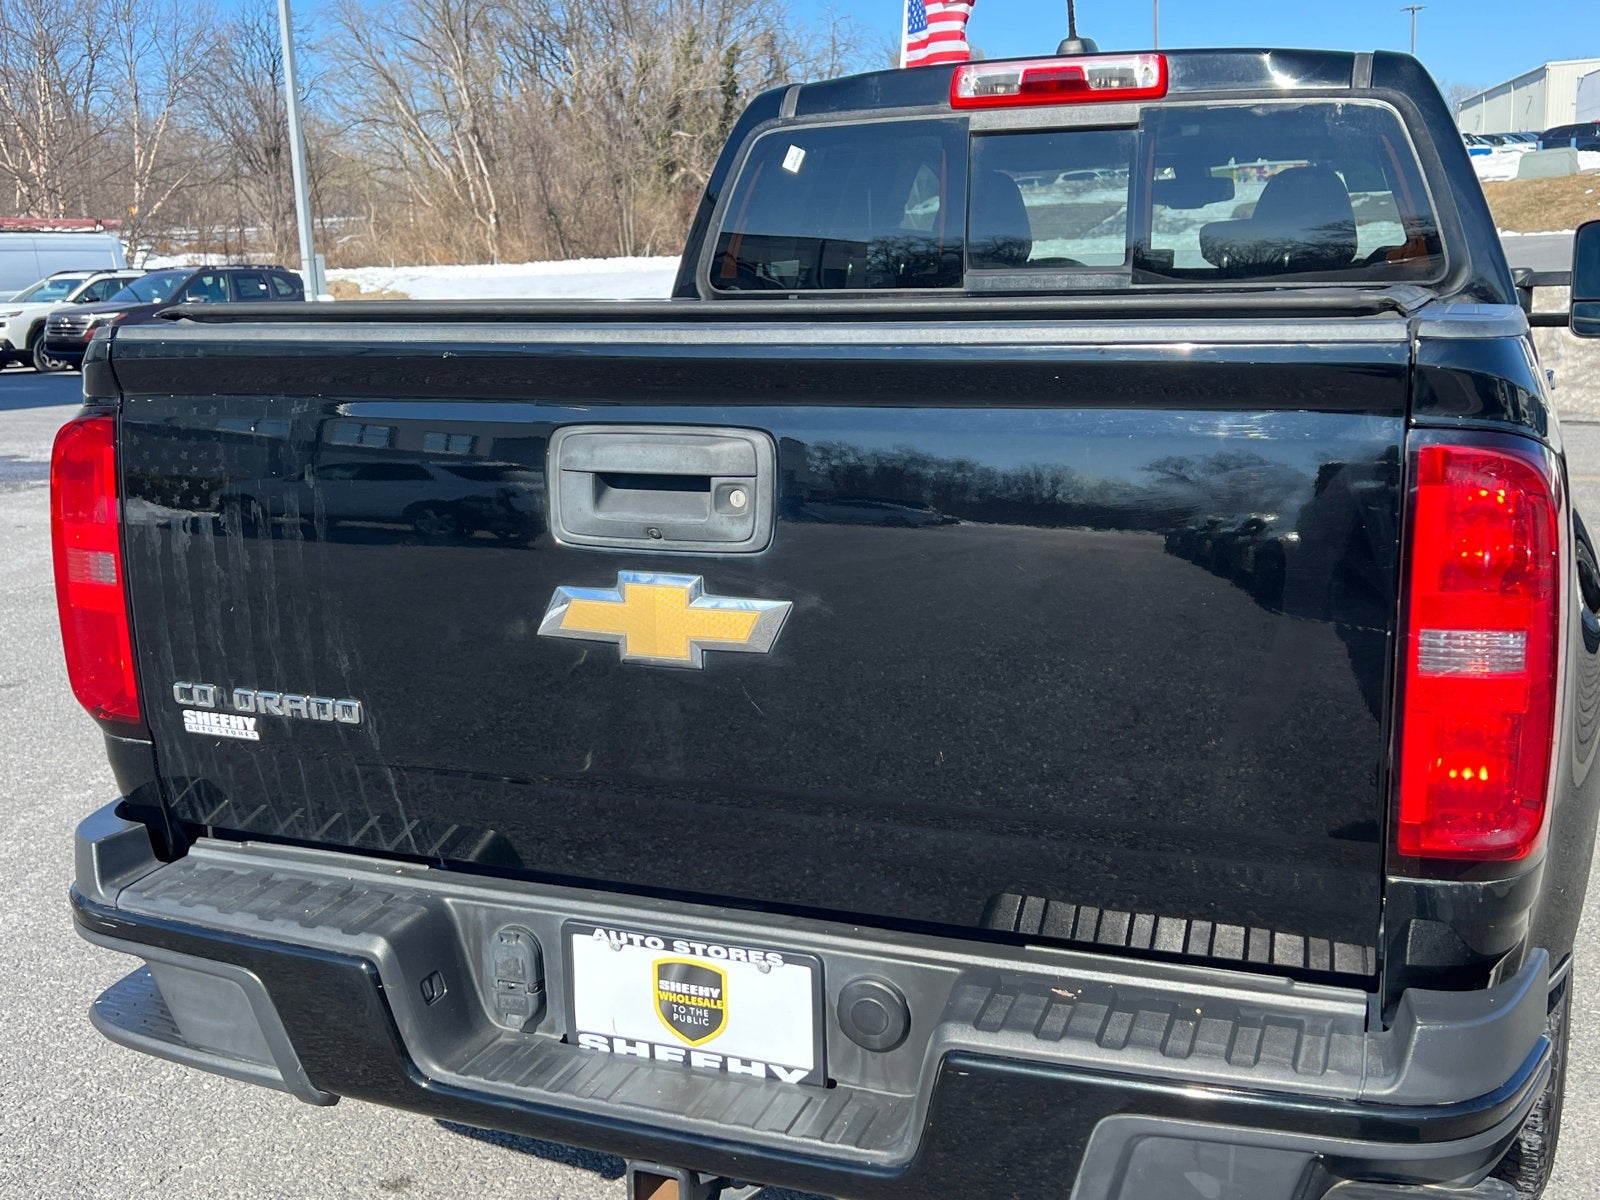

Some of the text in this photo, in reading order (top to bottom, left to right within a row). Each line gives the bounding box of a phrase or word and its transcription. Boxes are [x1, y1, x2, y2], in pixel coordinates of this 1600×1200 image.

[182, 709, 257, 732] SHEEHY
[187, 724, 214, 734] AUTO
[592, 928, 784, 967] AUTO STORES
[658, 980, 720, 999] SHEEHY
[658, 991, 723, 1009] WHOLESALE
[672, 1004, 709, 1018] TO THE
[672, 1013, 710, 1026] PUBLIC
